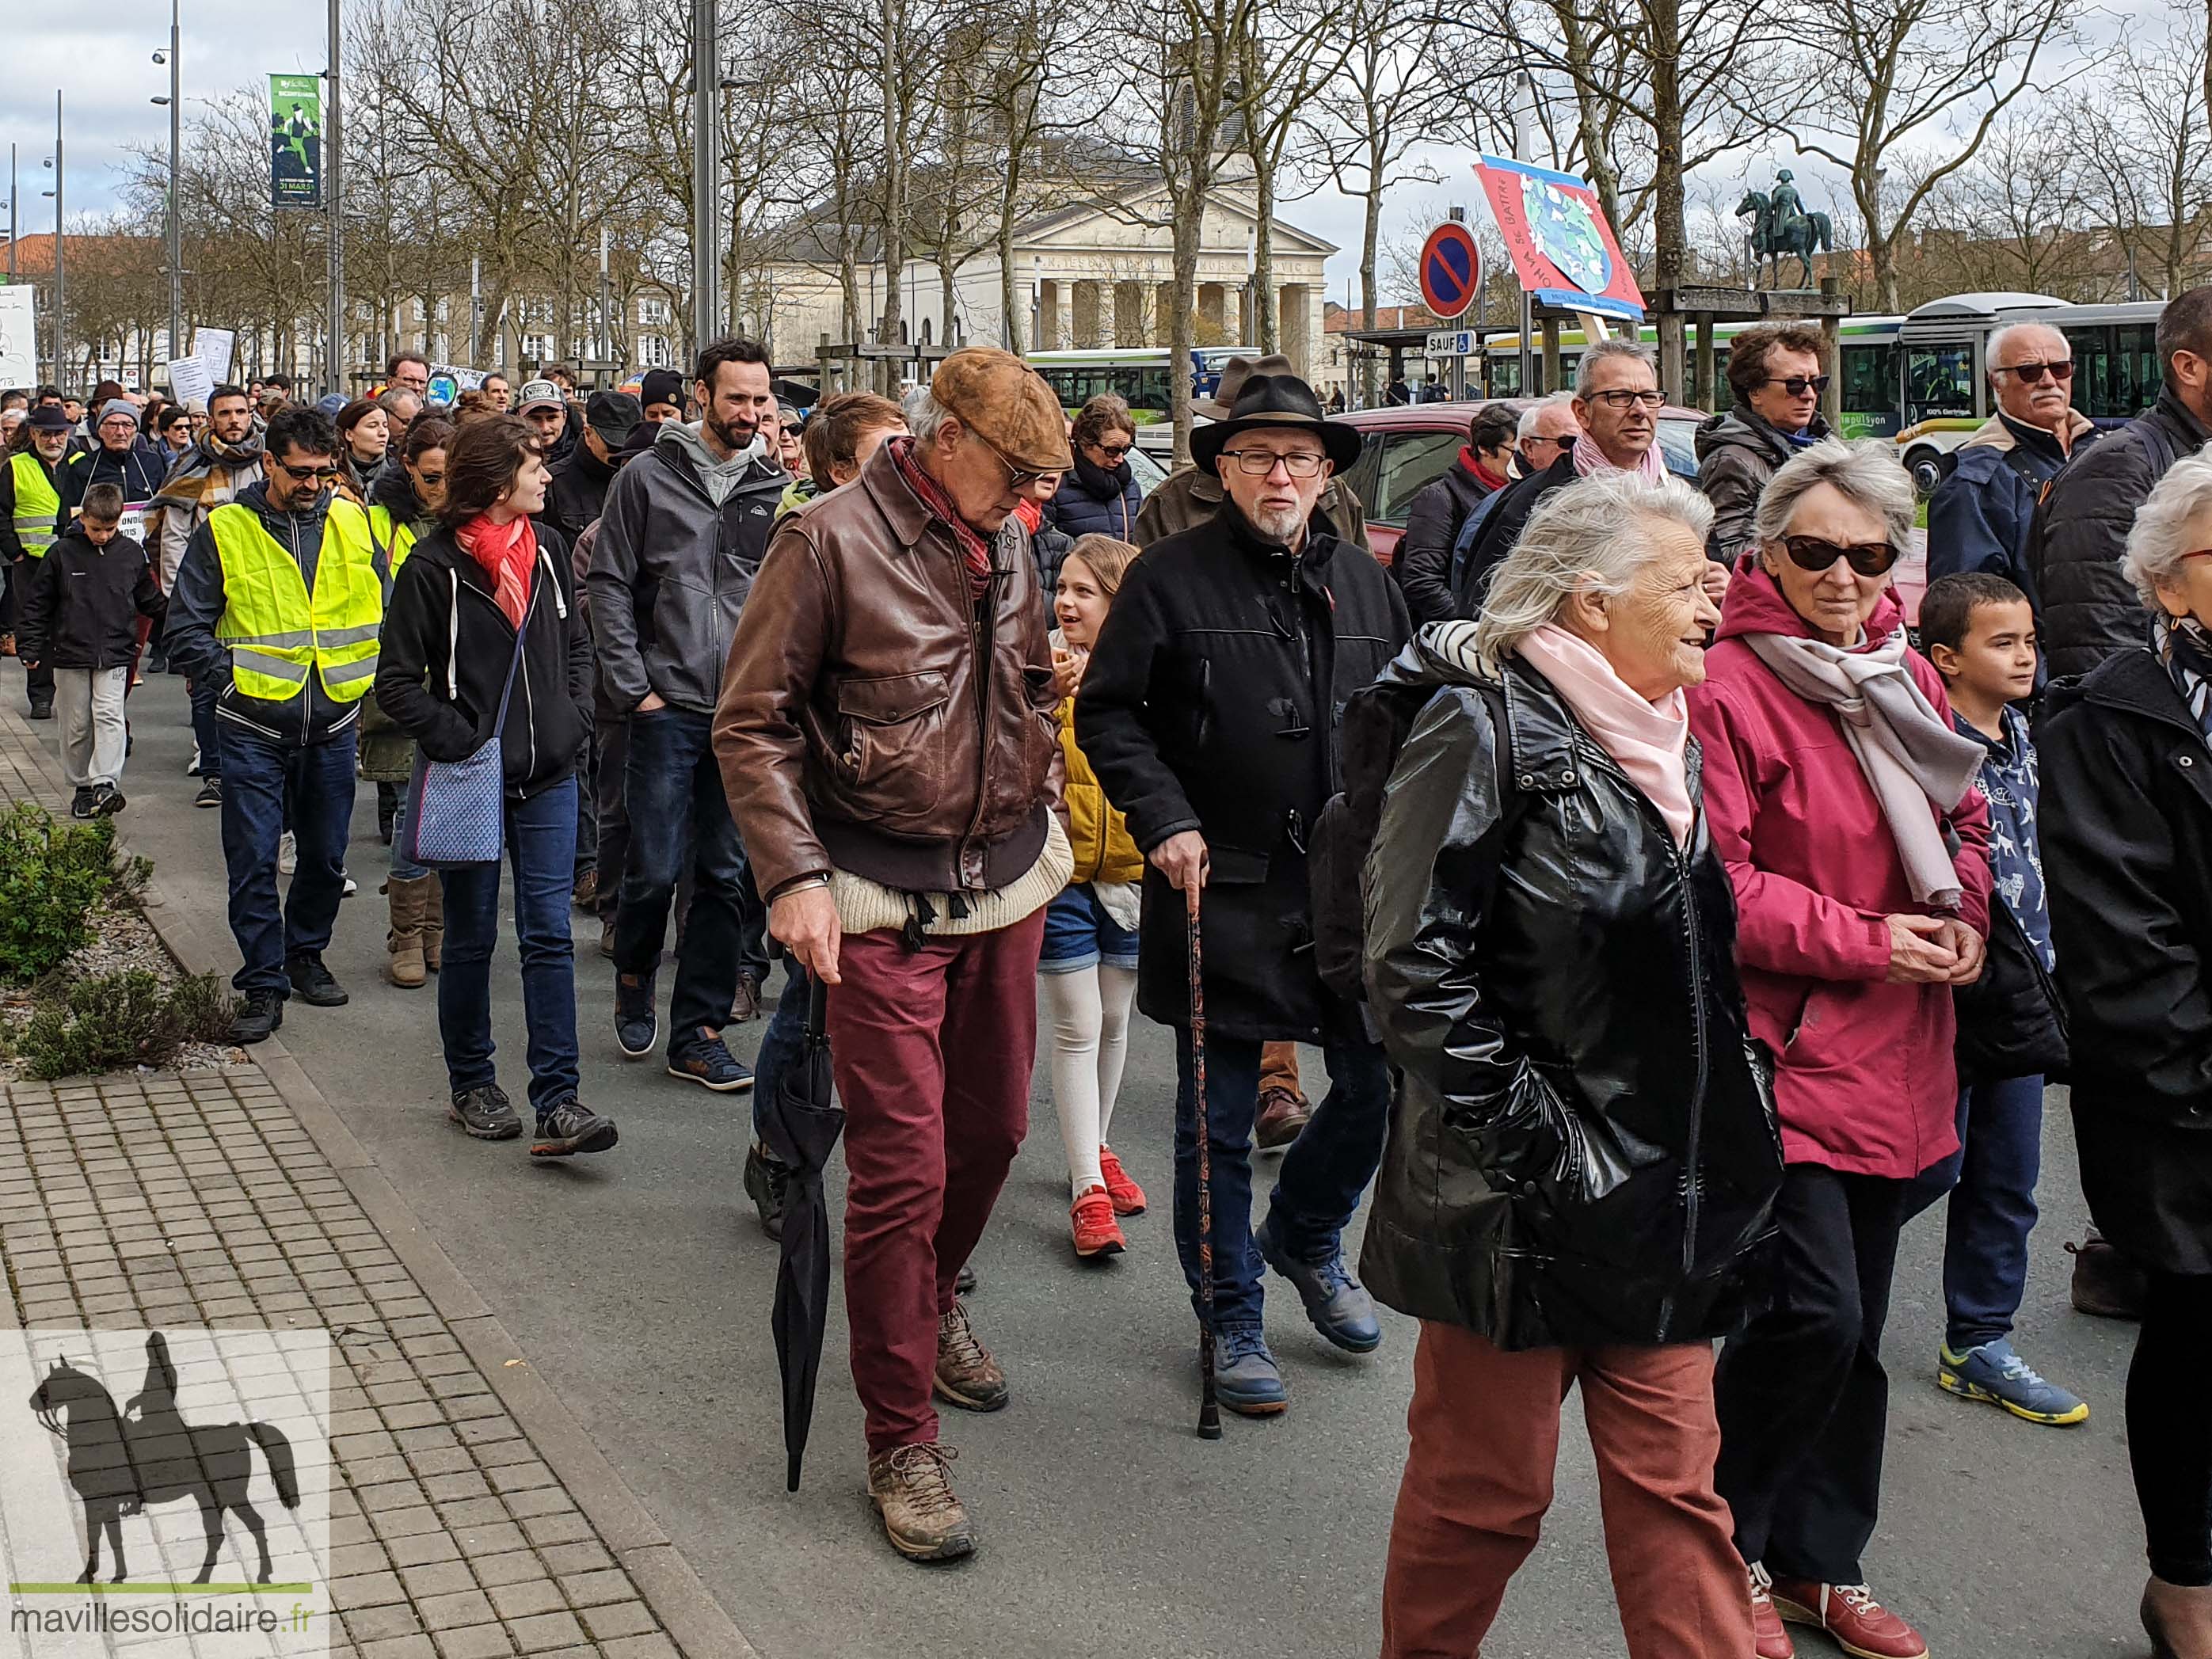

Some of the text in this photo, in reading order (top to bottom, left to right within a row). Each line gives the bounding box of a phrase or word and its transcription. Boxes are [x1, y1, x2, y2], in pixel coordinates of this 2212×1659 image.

[1498, 177, 1552, 287] ON VA SE BATTRE
[1430, 337, 1455, 352] SAUF
